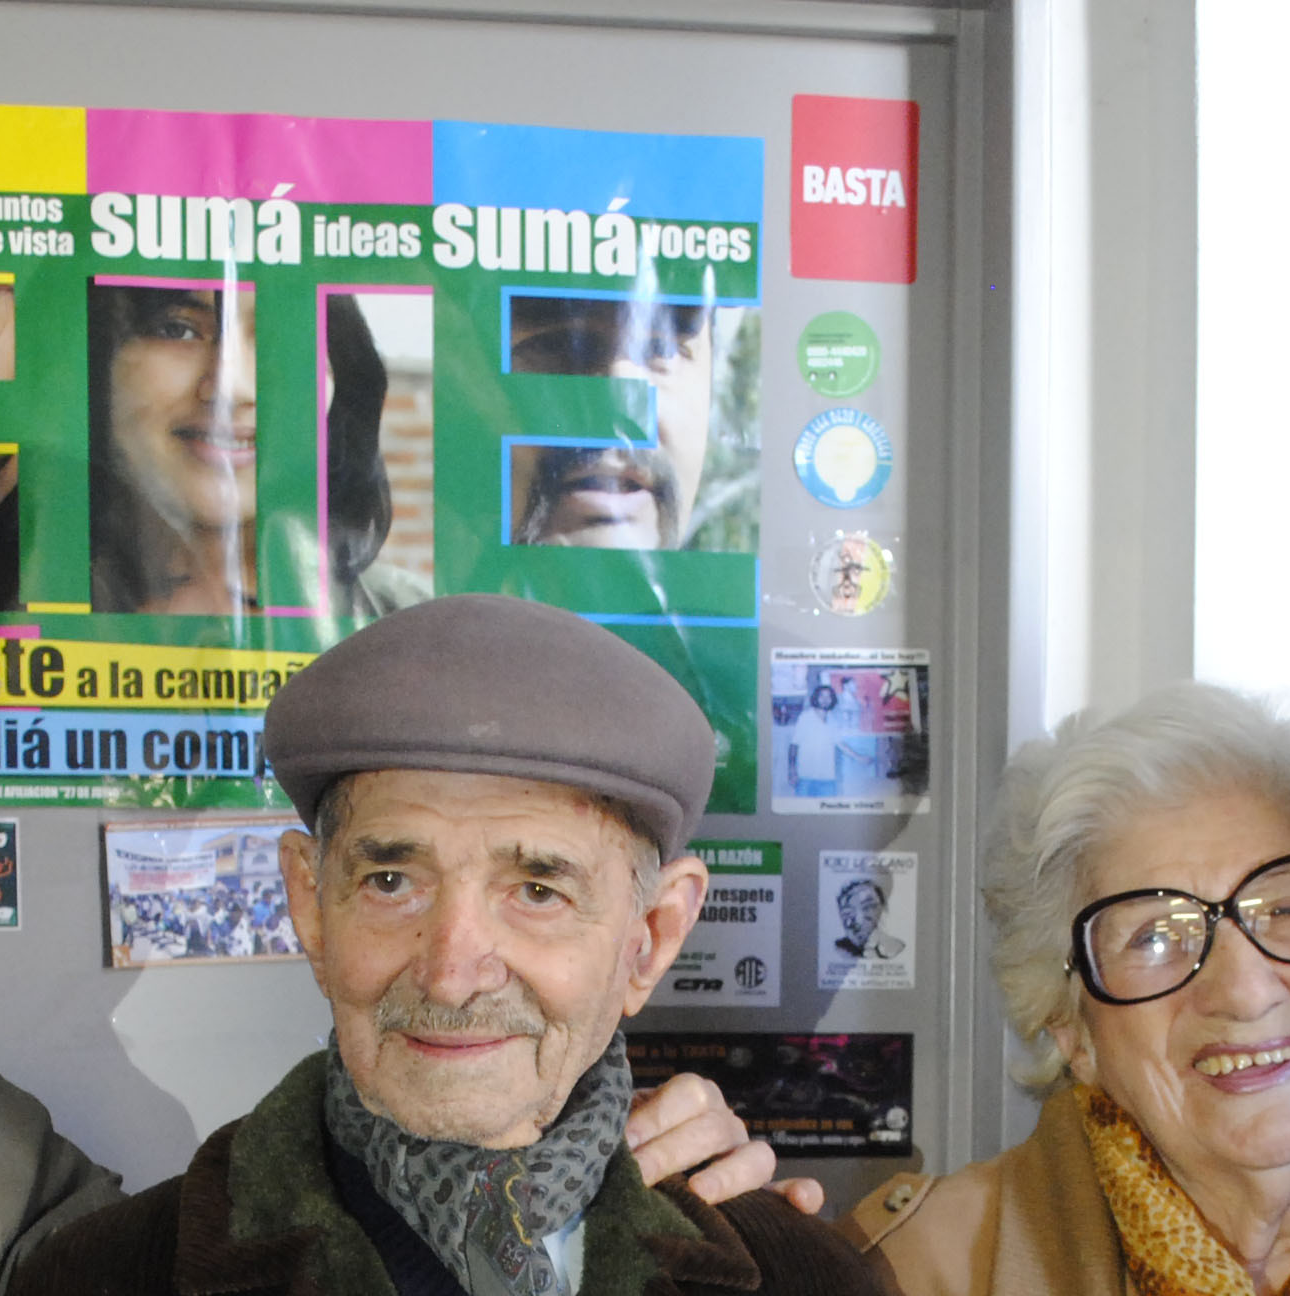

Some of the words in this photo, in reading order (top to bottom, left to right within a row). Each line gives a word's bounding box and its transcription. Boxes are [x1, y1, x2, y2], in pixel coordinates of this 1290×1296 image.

[802, 165, 906, 207] BASTA
[10, 224, 75, 257] vista
[90, 183, 302, 266] sumá
[313, 214, 422, 259] ideas
[432, 197, 637, 277] sumá
[642, 222, 752, 263] voces
[77, 667, 98, 698] a
[109, 661, 143, 699] la
[65, 728, 128, 770] un
[717, 846, 763, 867] RAZÓN
[713, 887, 775, 904] respete
[734, 955, 767, 989] ATE
